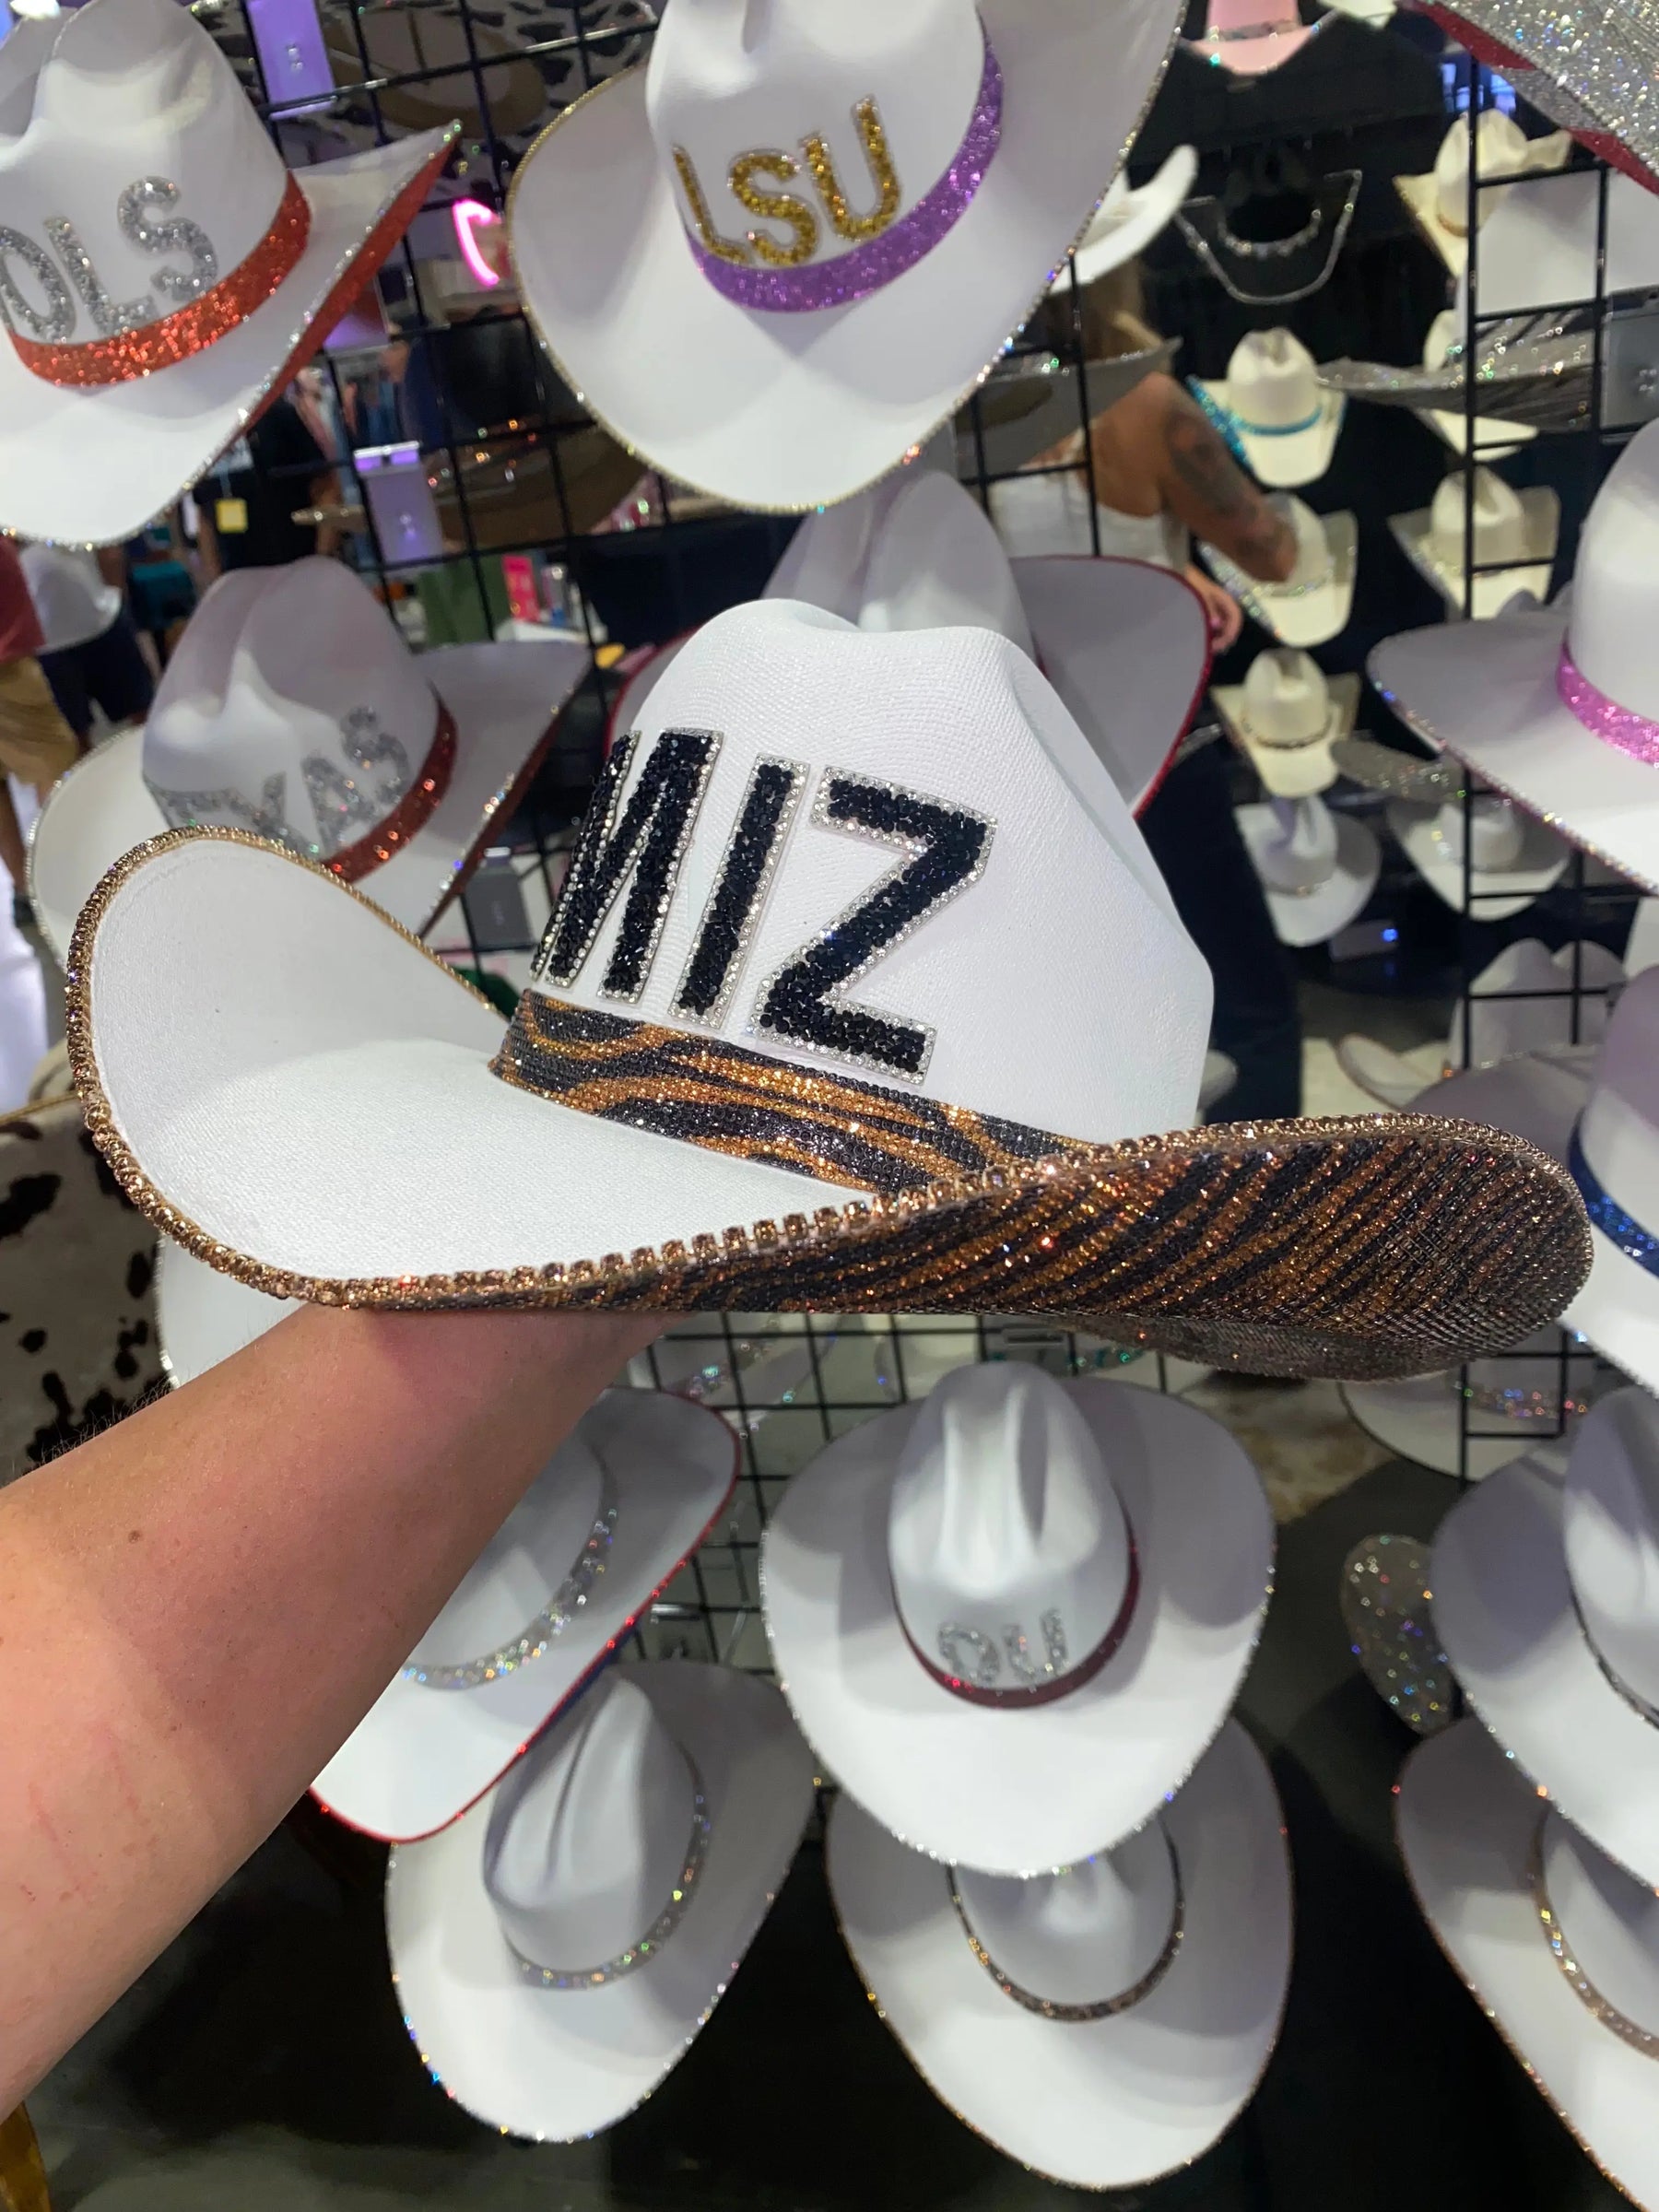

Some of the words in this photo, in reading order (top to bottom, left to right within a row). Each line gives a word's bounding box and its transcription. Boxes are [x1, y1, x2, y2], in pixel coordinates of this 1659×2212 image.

[0, 175, 218, 345] OLS
[671, 96, 900, 265] LSU
[529, 726, 997, 1085] MIZ
[936, 1607, 1069, 1688] OU
